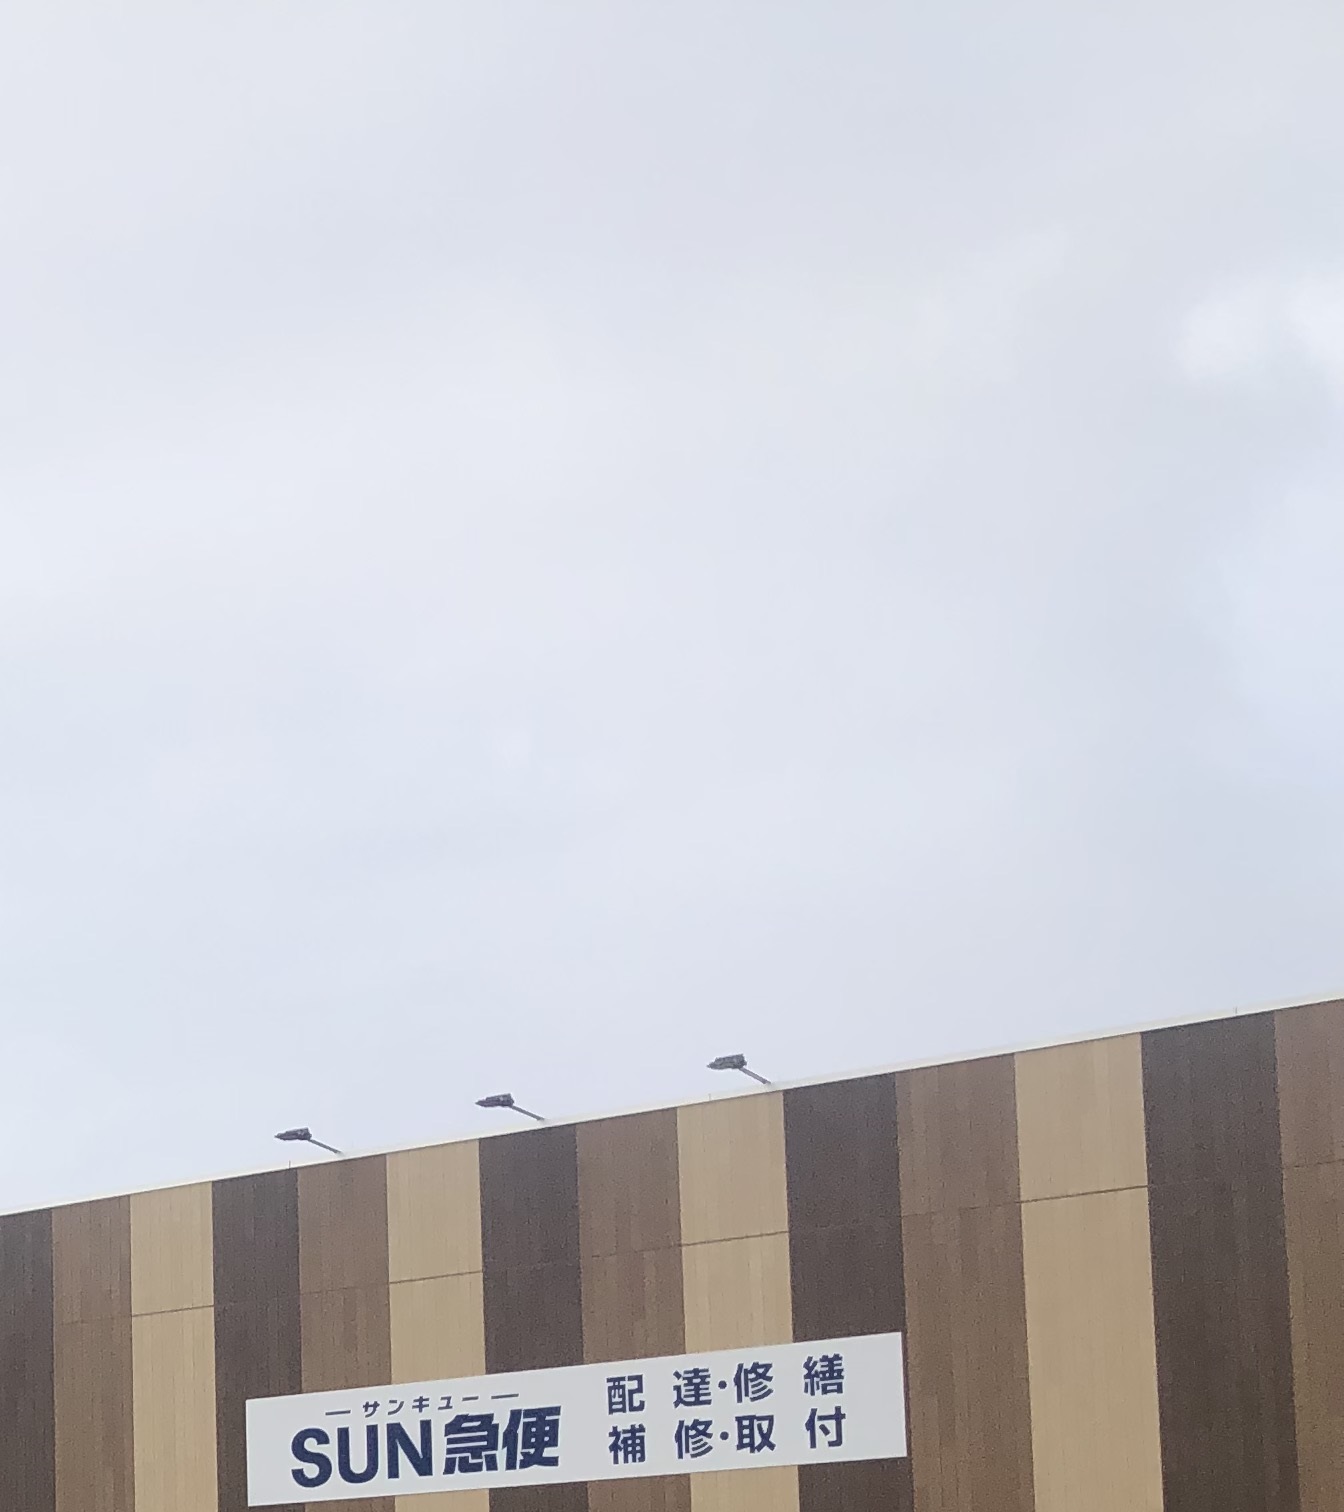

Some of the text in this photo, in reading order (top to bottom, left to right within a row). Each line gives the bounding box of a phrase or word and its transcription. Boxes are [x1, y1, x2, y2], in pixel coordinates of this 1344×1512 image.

[363, 1394, 480, 1418] サンキュー
[606, 1352, 846, 1414] 配達・修繕
[290, 1405, 562, 1488] SUN急便
[608, 1406, 847, 1465] 補修・取付
